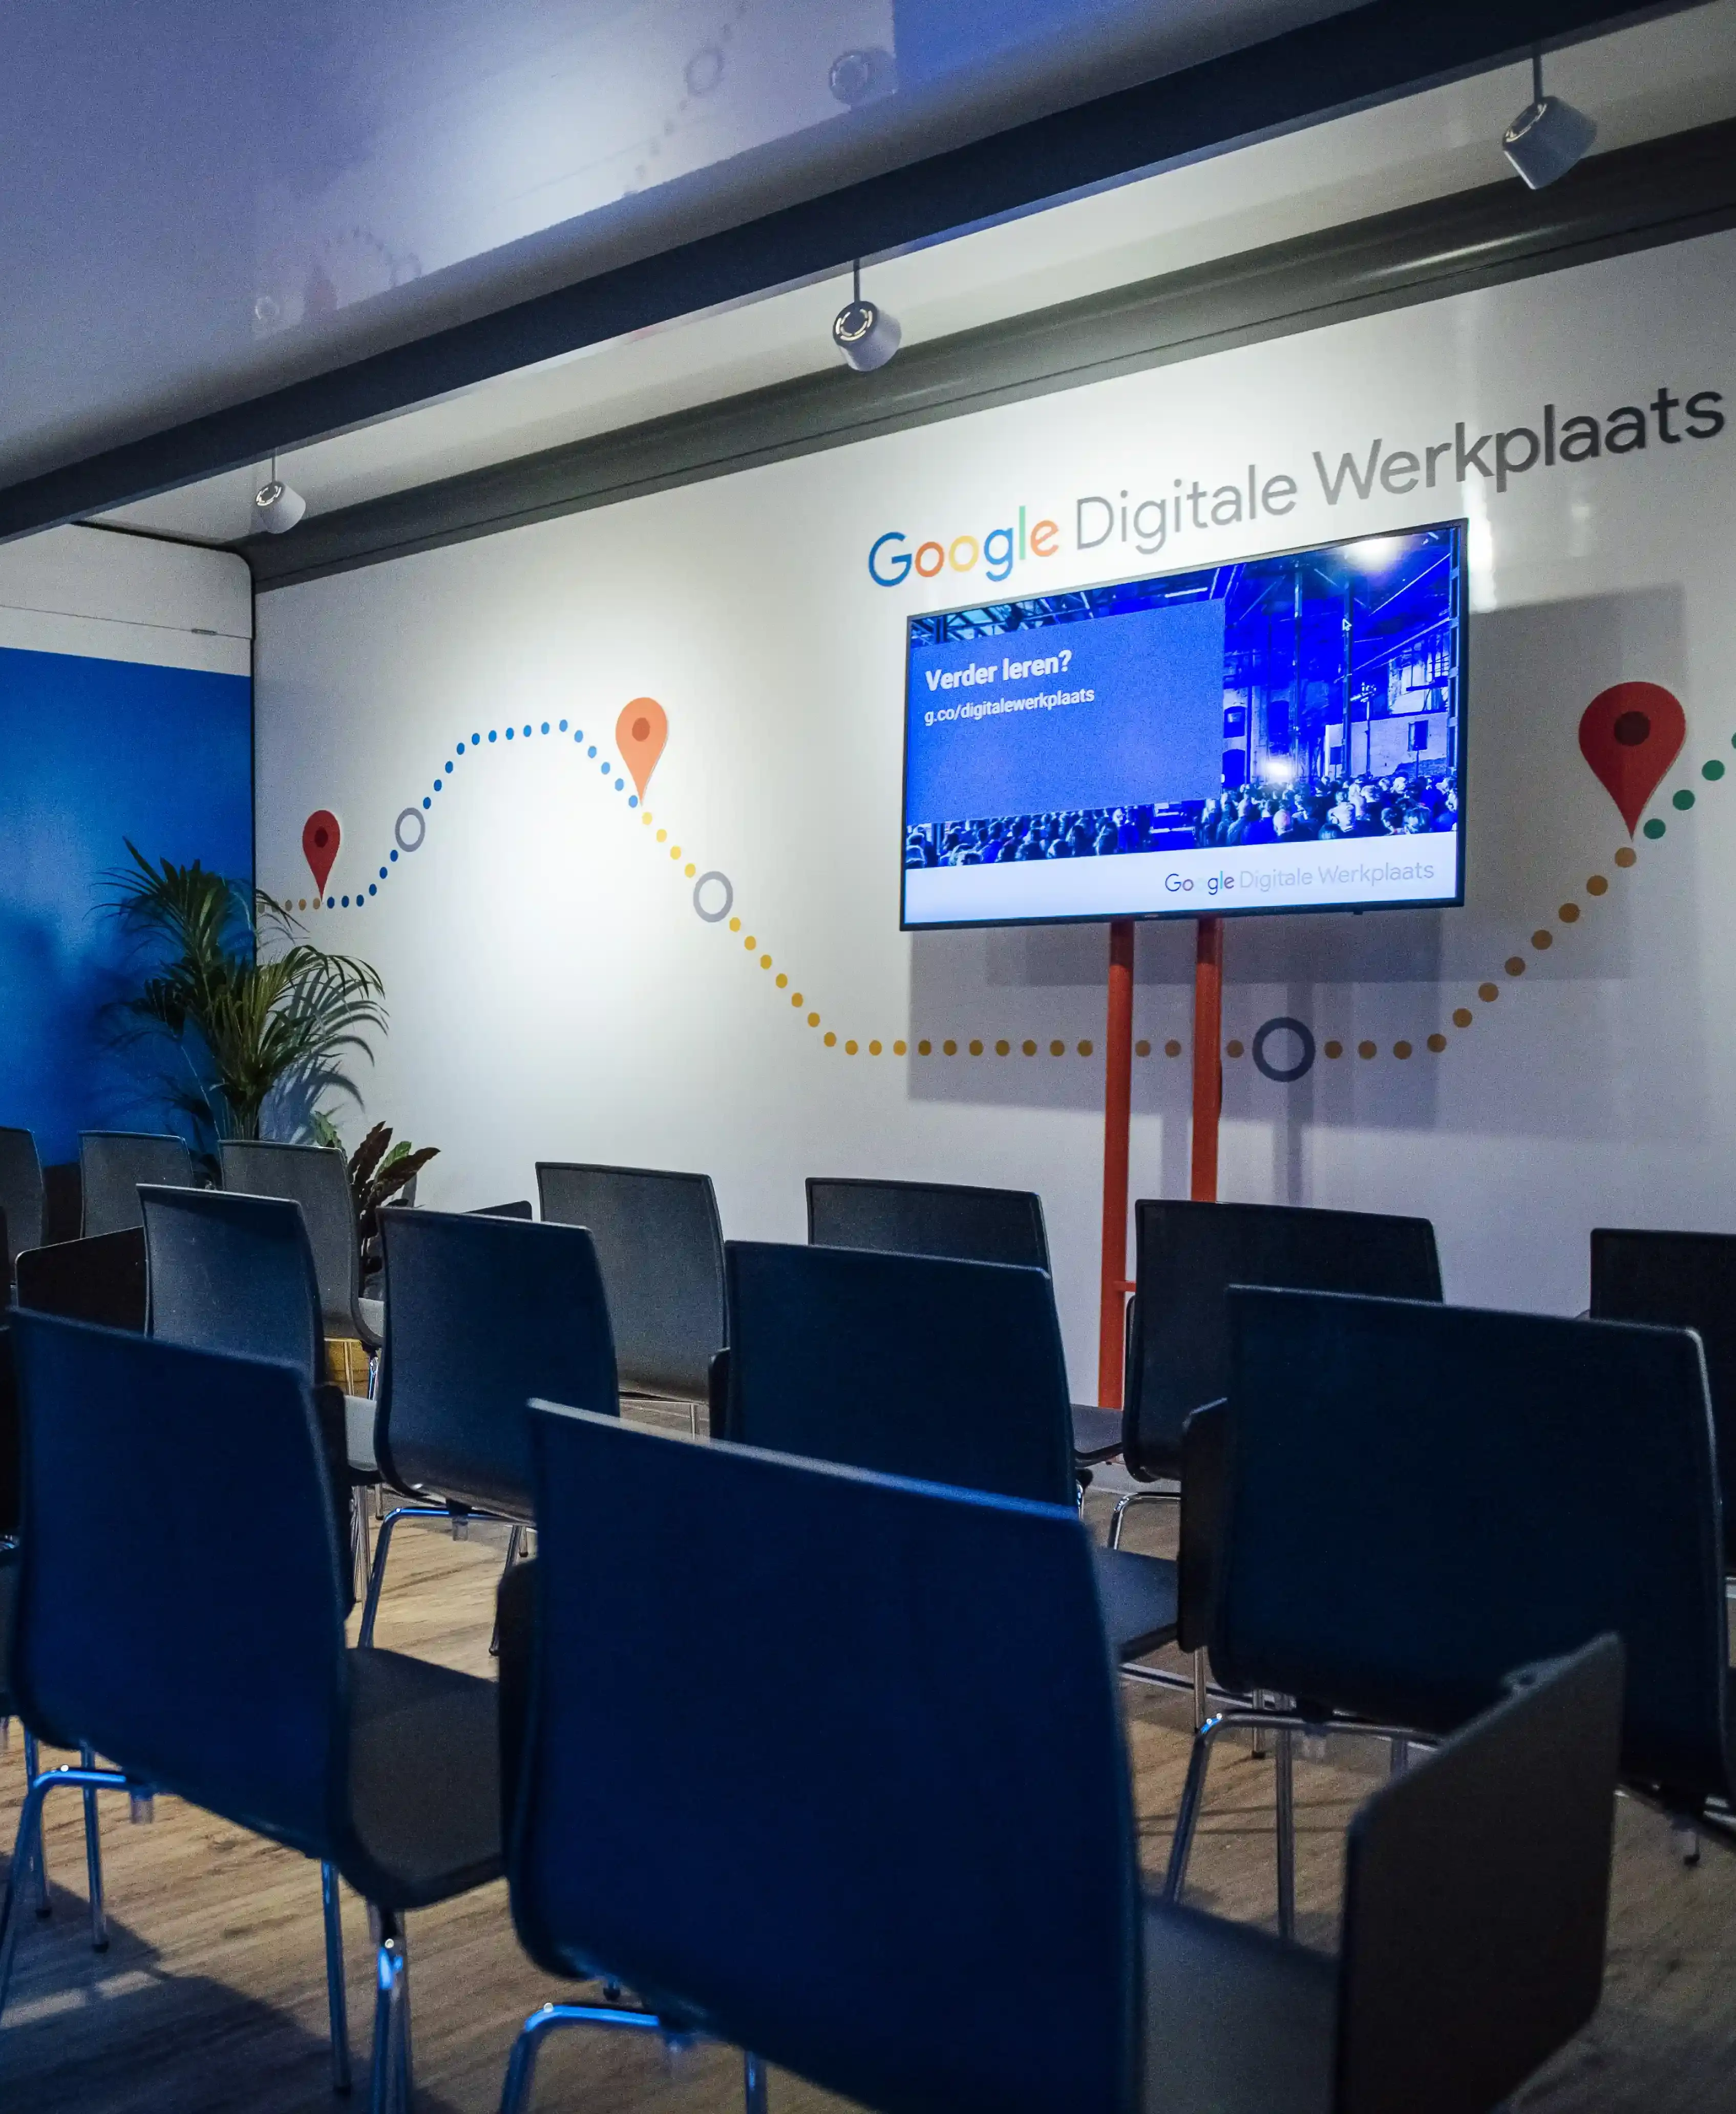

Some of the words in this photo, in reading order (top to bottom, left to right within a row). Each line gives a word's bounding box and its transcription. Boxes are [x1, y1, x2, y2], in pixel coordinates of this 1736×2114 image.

[869, 506, 1059, 587] Google
[1077, 465, 1297, 555] Digitale
[1312, 387, 1726, 505] Werkplaats
[925, 663, 998, 691] Verder
[1002, 649, 1072, 681] leren?
[924, 688, 1095, 726] g.co/digitalewerkplaats
[1165, 871, 1235, 895] Gogle
[1240, 866, 1312, 893] Digitale
[1318, 862, 1434, 886] Werkplaats
